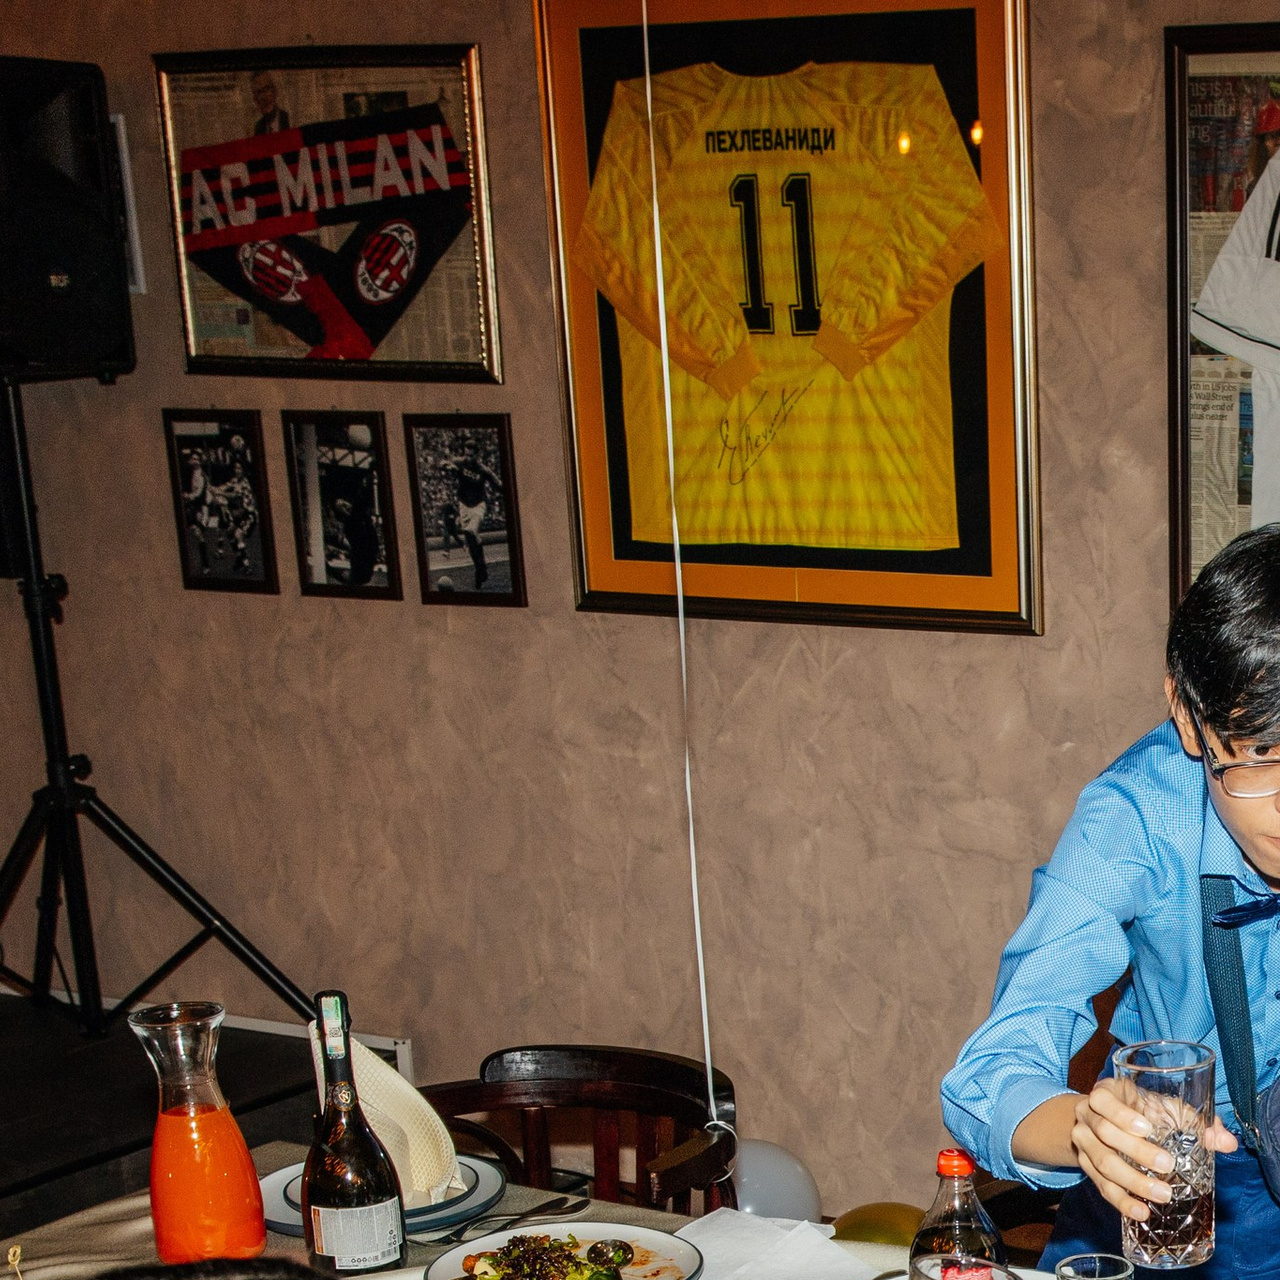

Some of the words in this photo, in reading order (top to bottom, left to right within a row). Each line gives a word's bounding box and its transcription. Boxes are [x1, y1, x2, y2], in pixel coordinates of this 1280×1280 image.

[705, 128, 836, 155] ПЕХЛЕВАНИДИ
[191, 162, 257, 234] AC
[273, 125, 451, 217] MILAN
[729, 173, 822, 336] 11
[1195, 392, 1211, 400] Wall
[1211, 392, 1233, 401] Street
[1222, 383, 1236, 392] jobs
